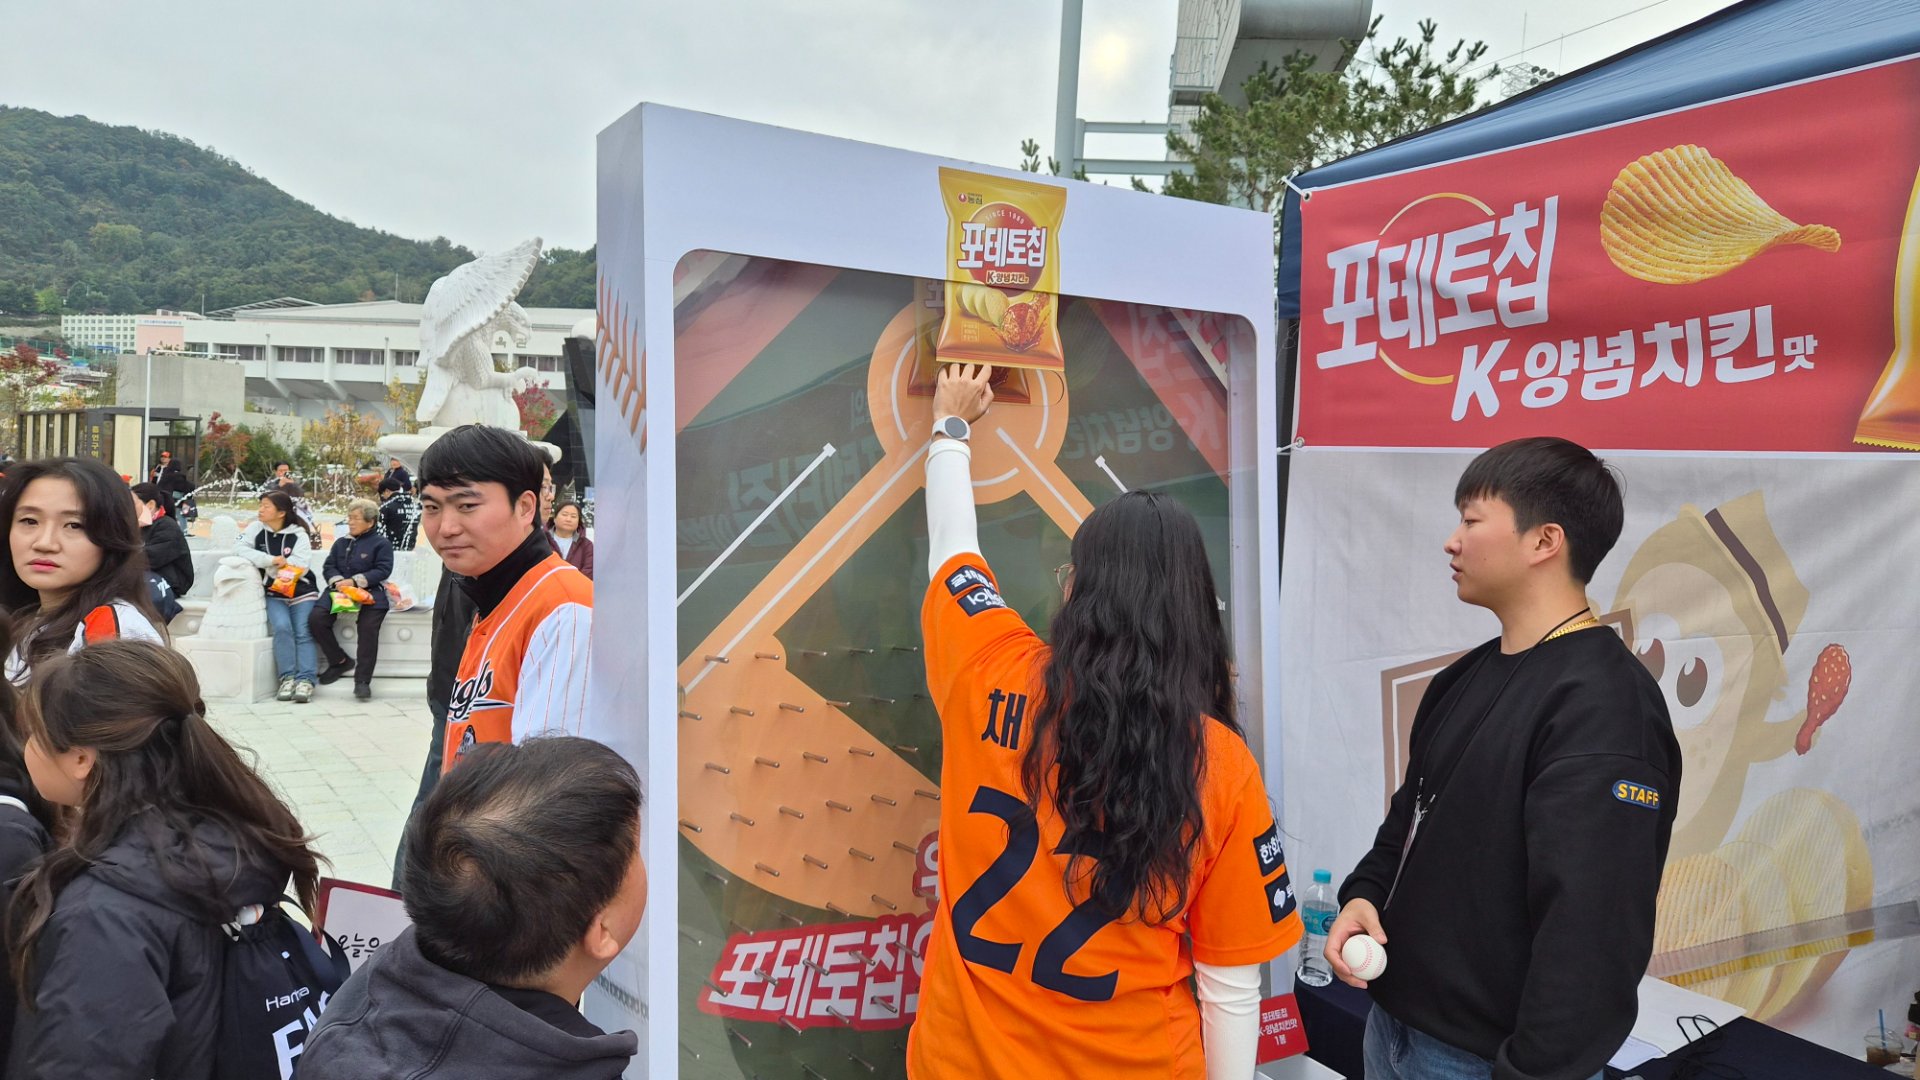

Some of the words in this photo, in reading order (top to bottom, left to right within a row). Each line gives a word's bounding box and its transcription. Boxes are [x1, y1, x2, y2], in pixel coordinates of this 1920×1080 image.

[957, 222, 1047, 268] 포테토칩
[1316, 195, 1559, 370] 포테토칩
[1617, 783, 1659, 806] STAFF
[951, 785, 1120, 1001] 22
[1261, 1007, 1288, 1023] 포테토칩
